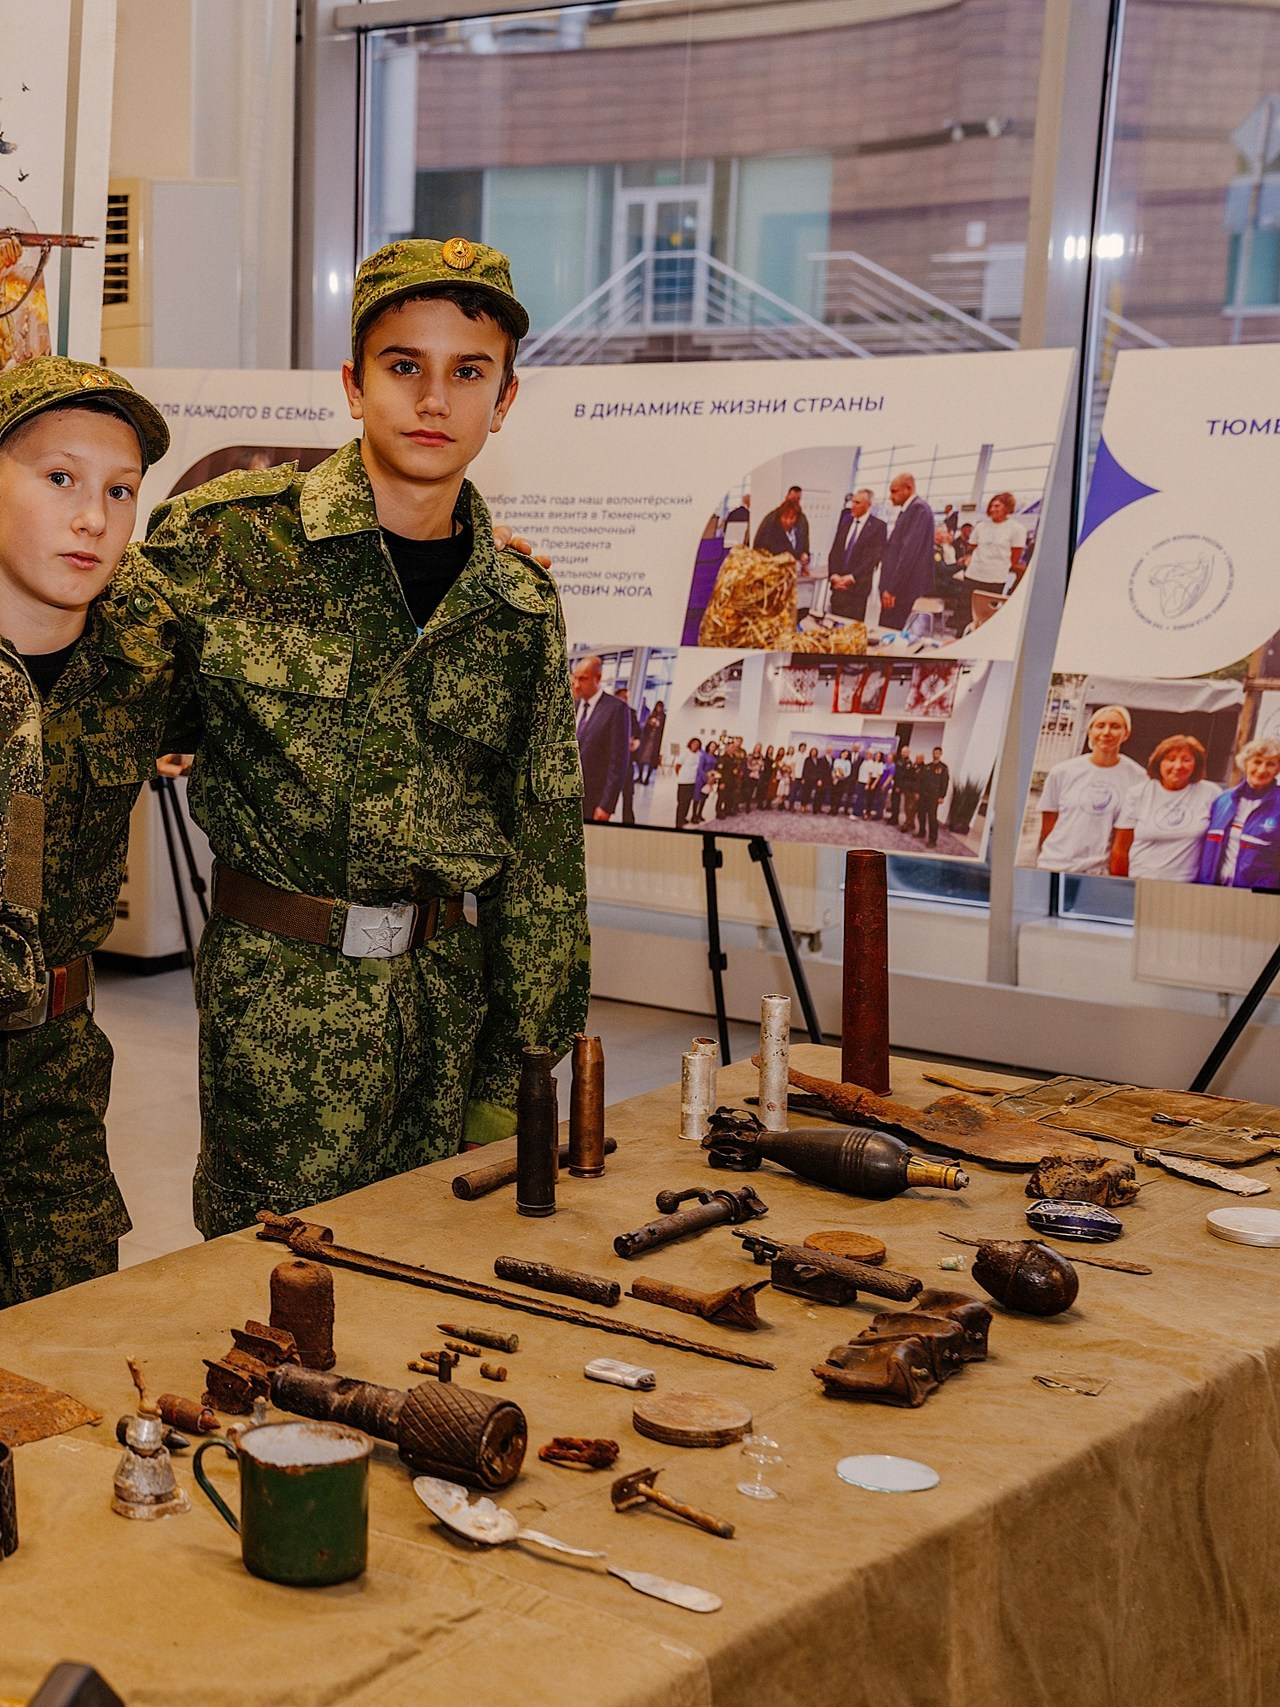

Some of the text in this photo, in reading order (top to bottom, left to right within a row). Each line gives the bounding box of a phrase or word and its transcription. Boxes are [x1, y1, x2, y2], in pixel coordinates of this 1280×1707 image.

[183, 404, 258, 420] КАЖДОГО
[261, 406, 272, 419] В
[574, 395, 885, 420] В ДИНАМИКЕ ЖИЗНИ СТРАНЫ
[541, 539, 612, 551] Президента
[613, 585, 653, 598] ЖОГА
